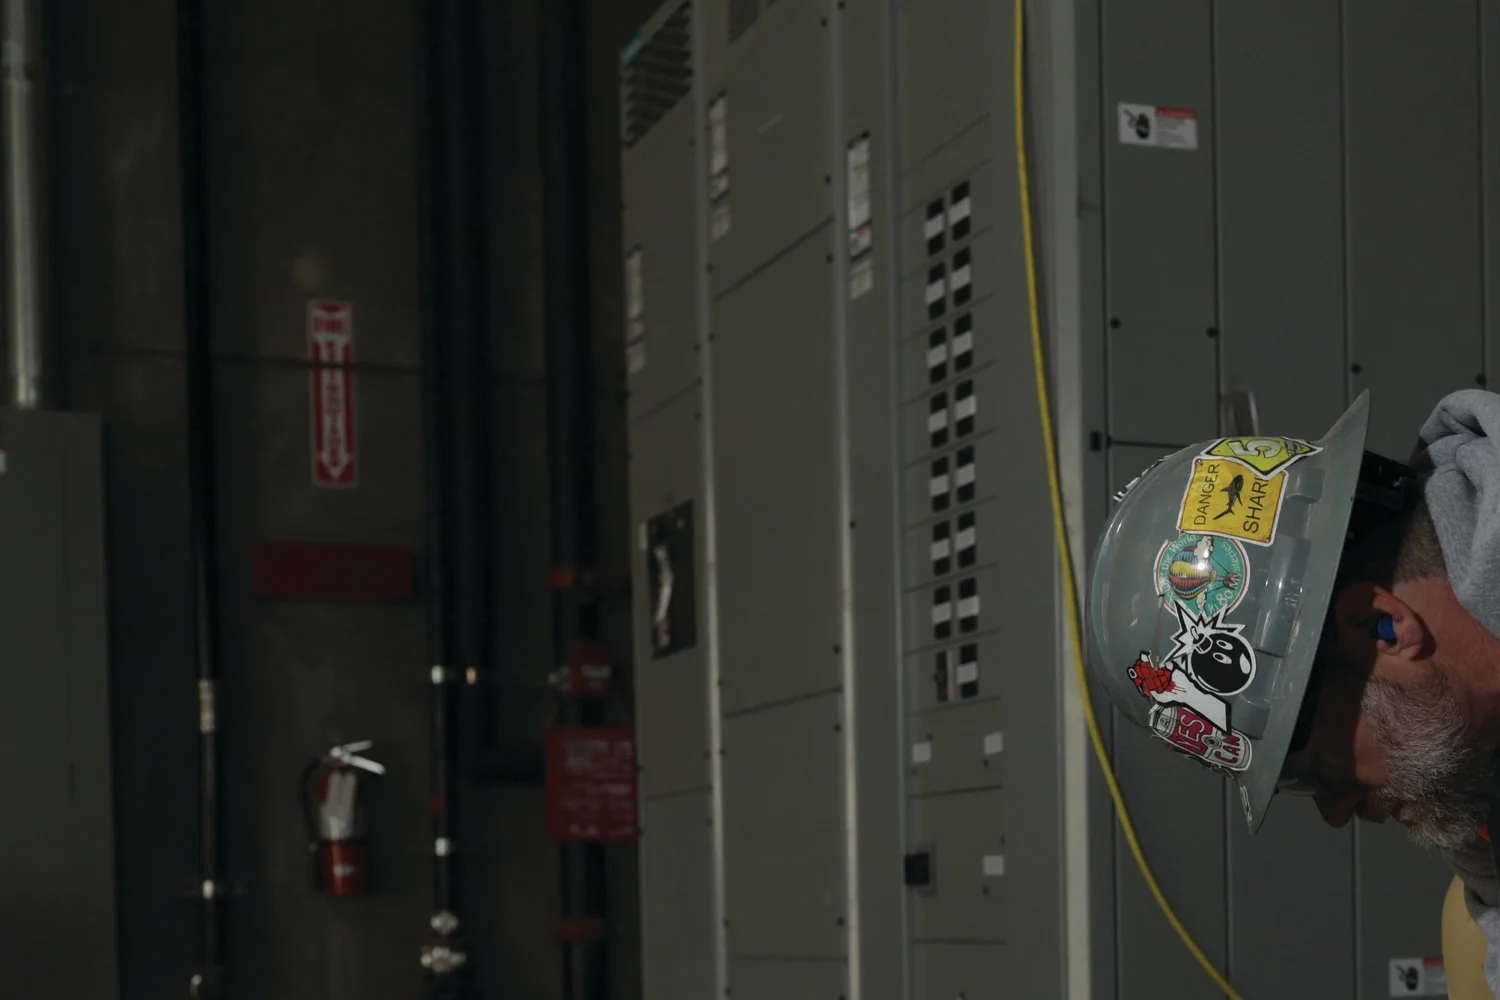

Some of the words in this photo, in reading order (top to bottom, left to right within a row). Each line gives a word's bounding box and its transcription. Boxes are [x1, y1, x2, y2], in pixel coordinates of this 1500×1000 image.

[1227, 440, 1281, 458] 5
[1193, 463, 1220, 526] DANGER
[1176, 714, 1205, 750] YES
[1215, 735, 1241, 764] CAN
